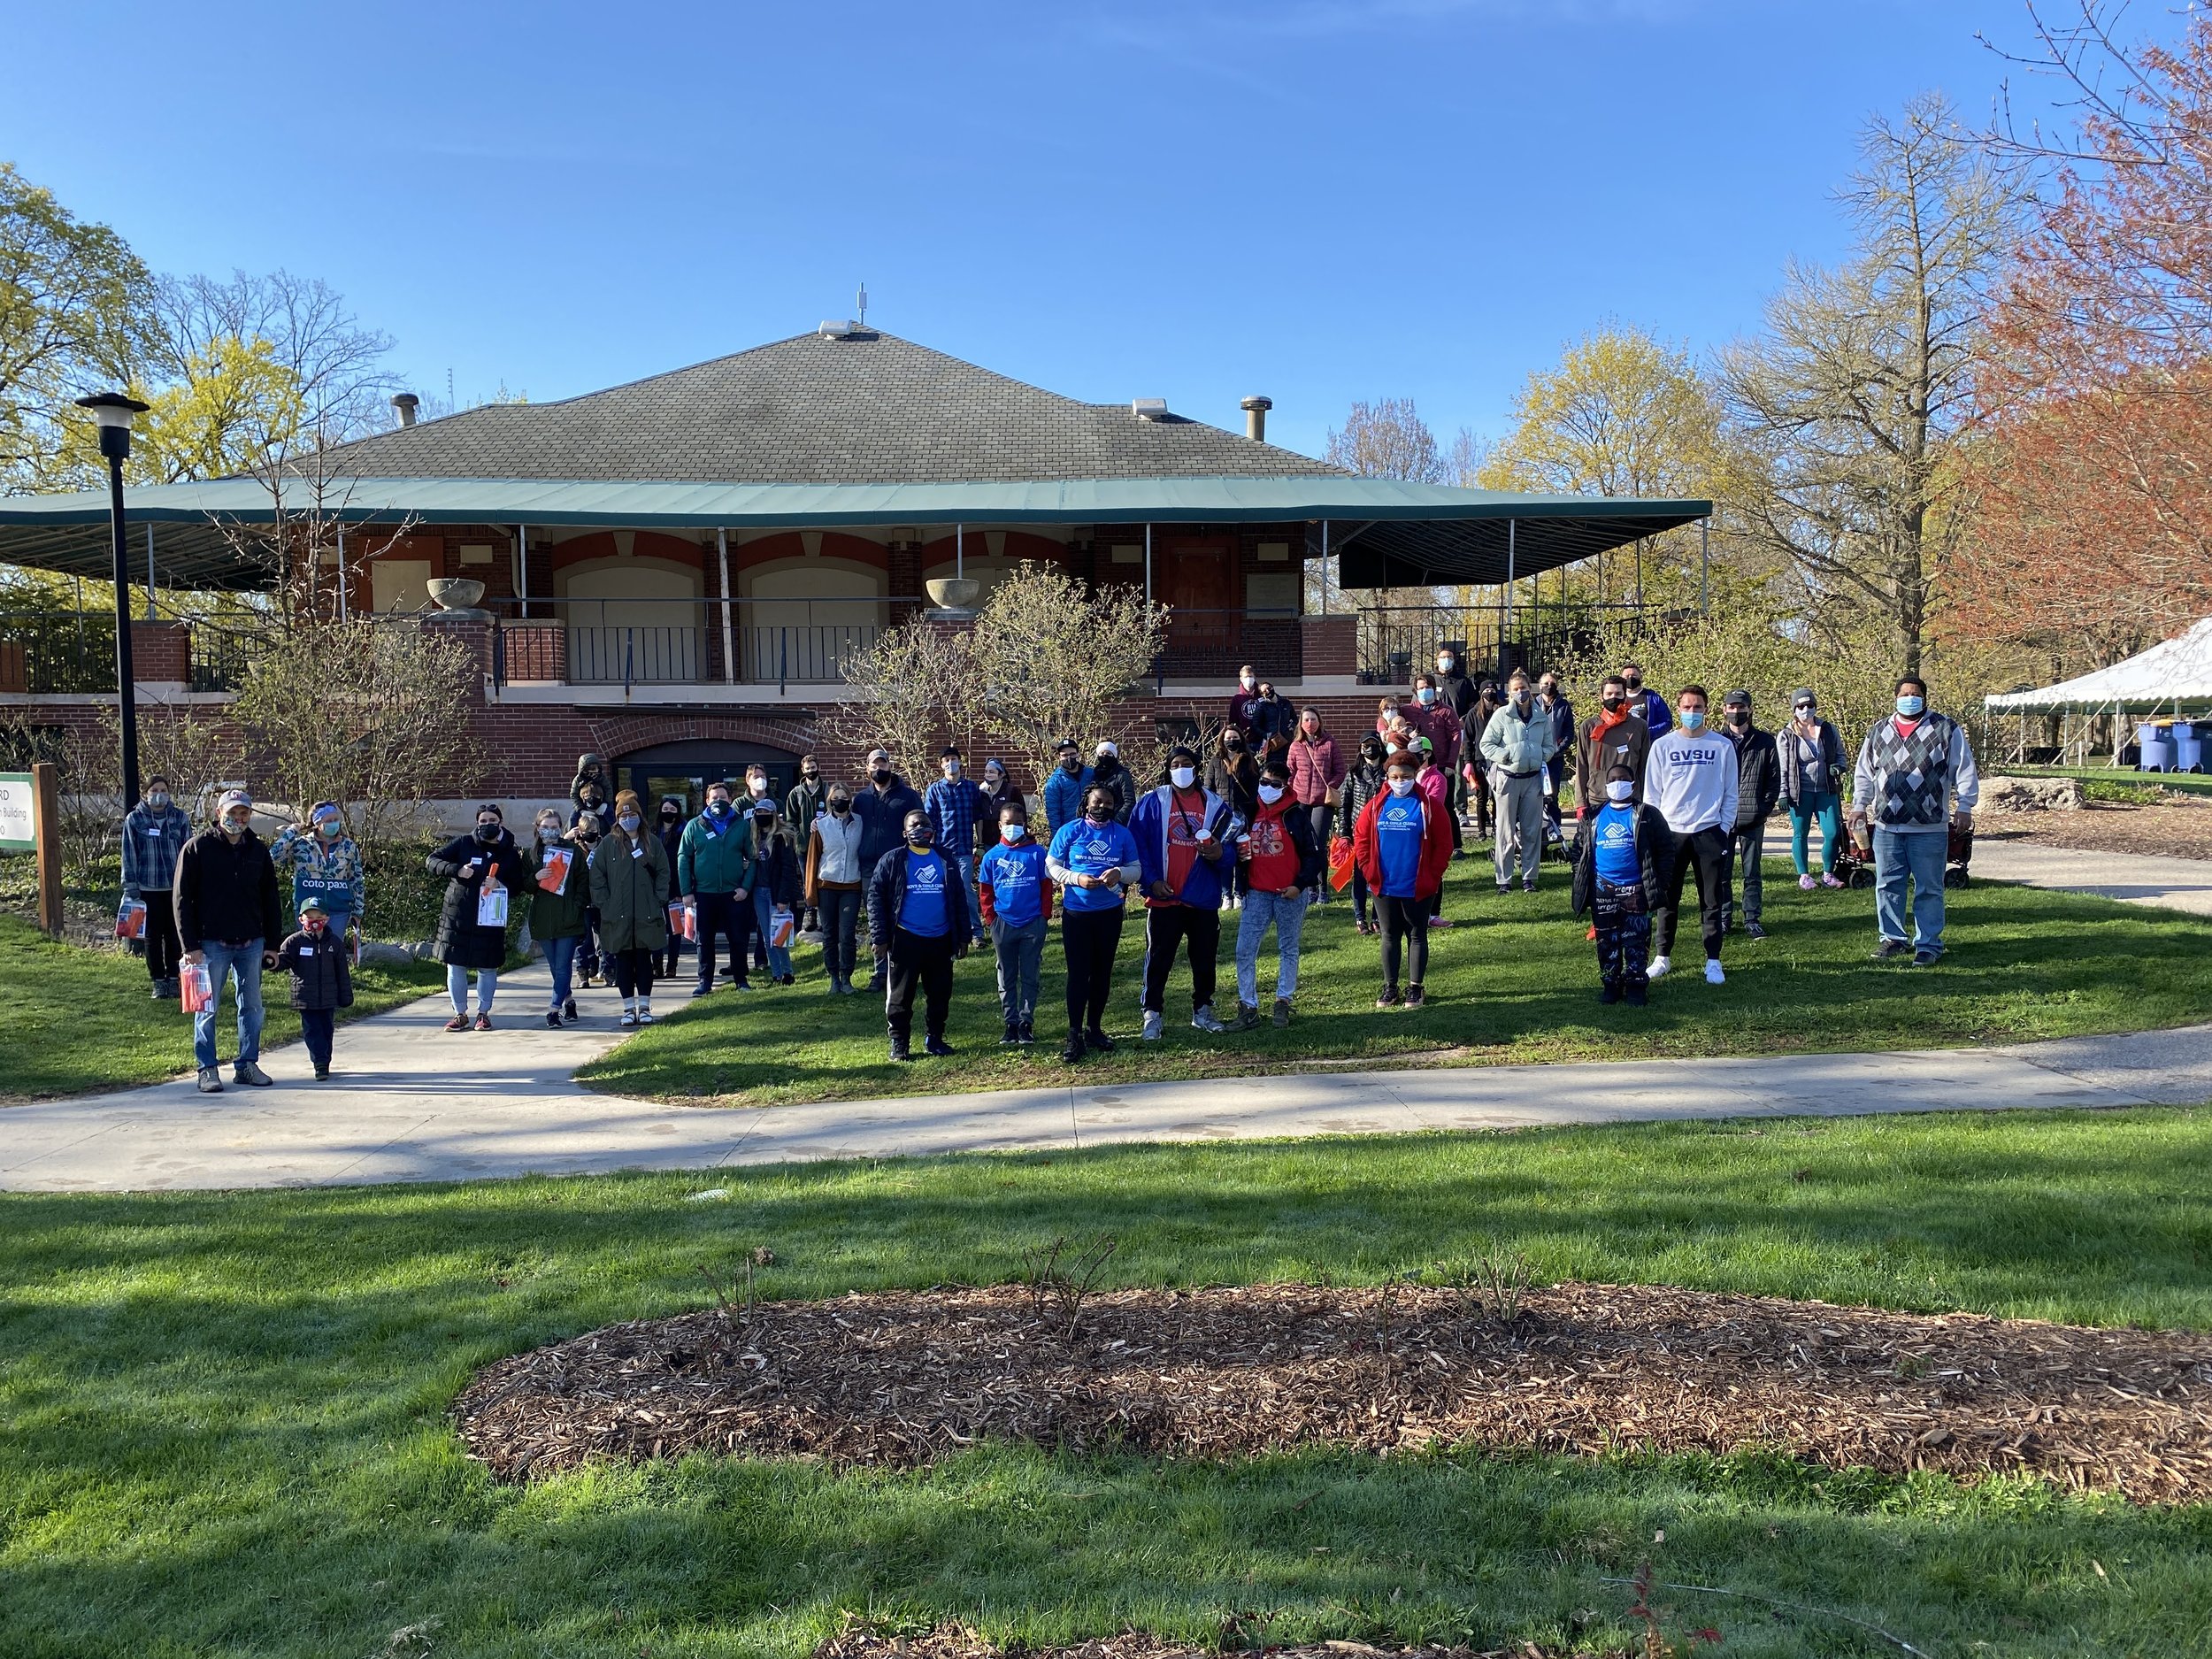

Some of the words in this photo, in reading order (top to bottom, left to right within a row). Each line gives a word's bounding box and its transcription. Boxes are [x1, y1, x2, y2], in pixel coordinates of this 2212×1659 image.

[1670, 749, 1716, 761] GVSU
[4, 807, 27, 821] Building
[303, 879, 325, 888] coto
